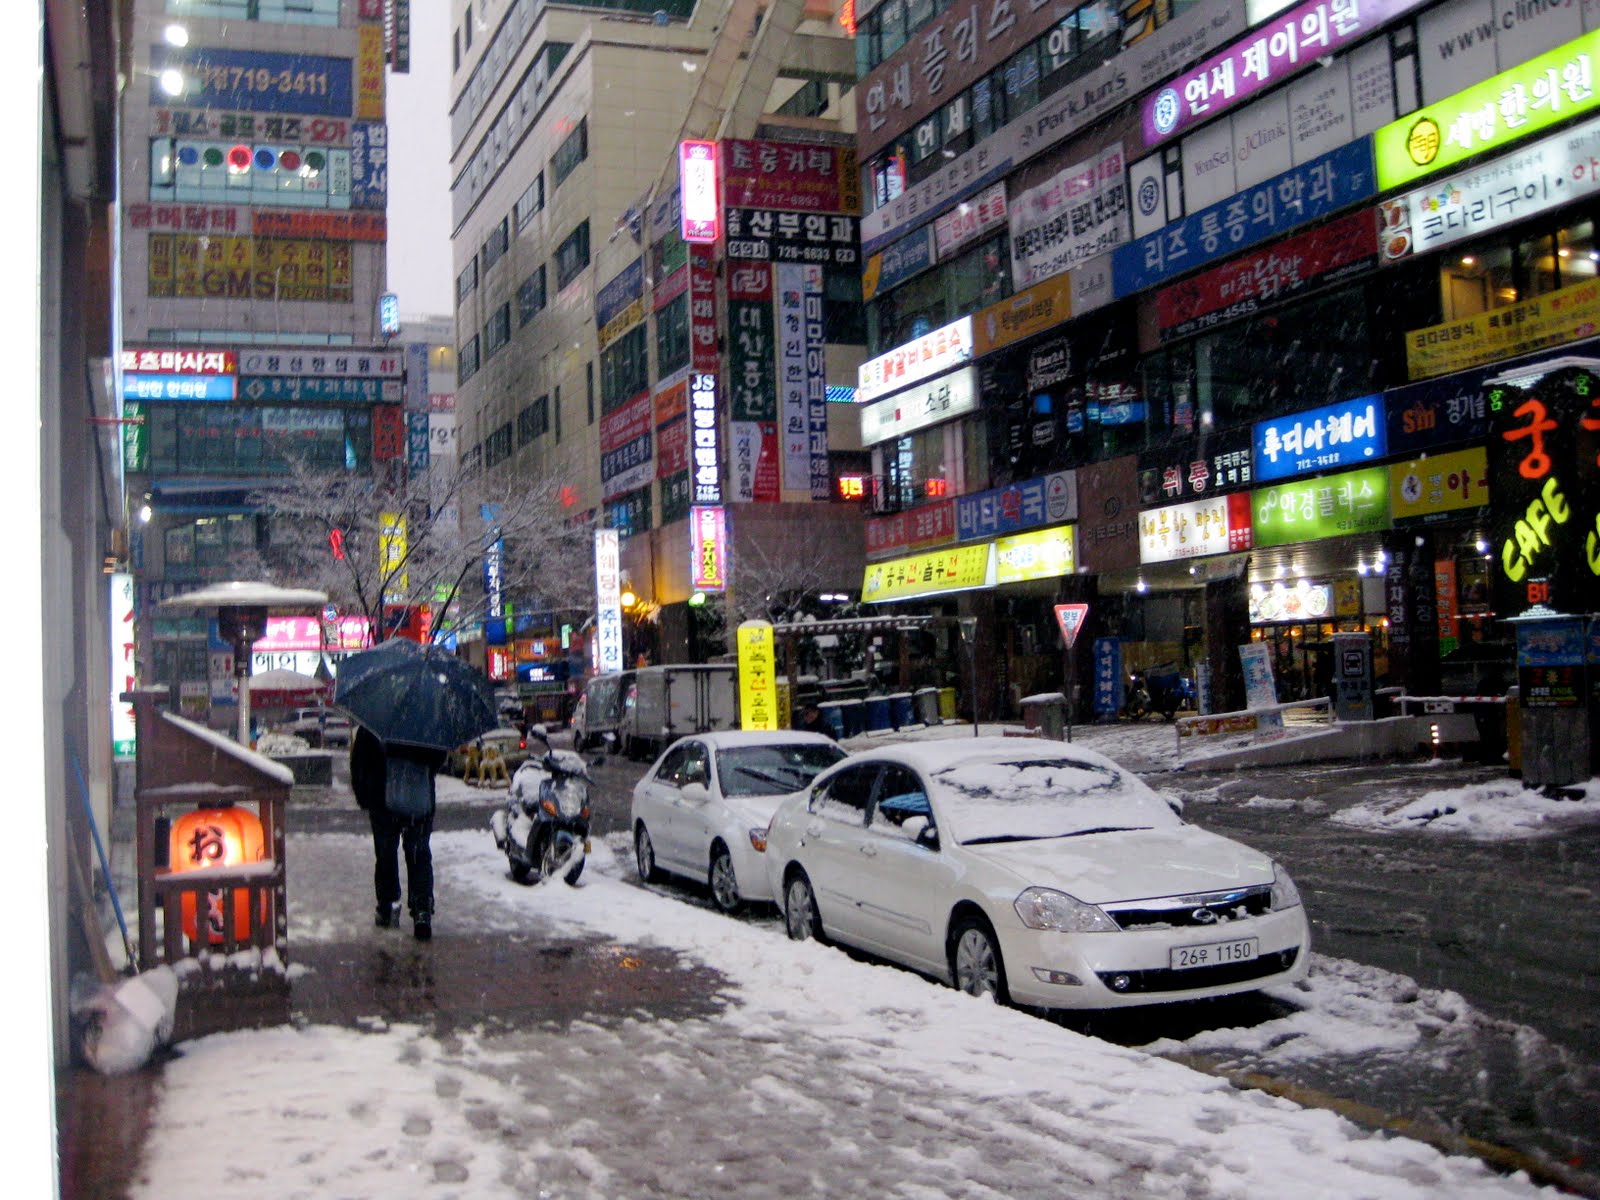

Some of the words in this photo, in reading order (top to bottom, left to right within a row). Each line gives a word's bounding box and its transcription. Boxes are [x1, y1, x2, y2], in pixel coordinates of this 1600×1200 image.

[1184, 58, 1235, 117] 연세
[1241, 0, 1361, 81] 제이의원
[749, 211, 853, 242] 산부인과
[1144, 218, 1189, 272] 리즈
[1199, 159, 1336, 252] 통증의학과
[1422, 174, 1548, 242] 코다리구이
[203, 270, 276, 296] GMS
[1502, 399, 1558, 479] 궁
[959, 483, 1045, 532] 바다약국
[1502, 477, 1571, 582] CAFE
[600, 609, 619, 662] 주차장
[1180, 949, 1209, 966] 26우
[1216, 942, 1251, 959] 1150
